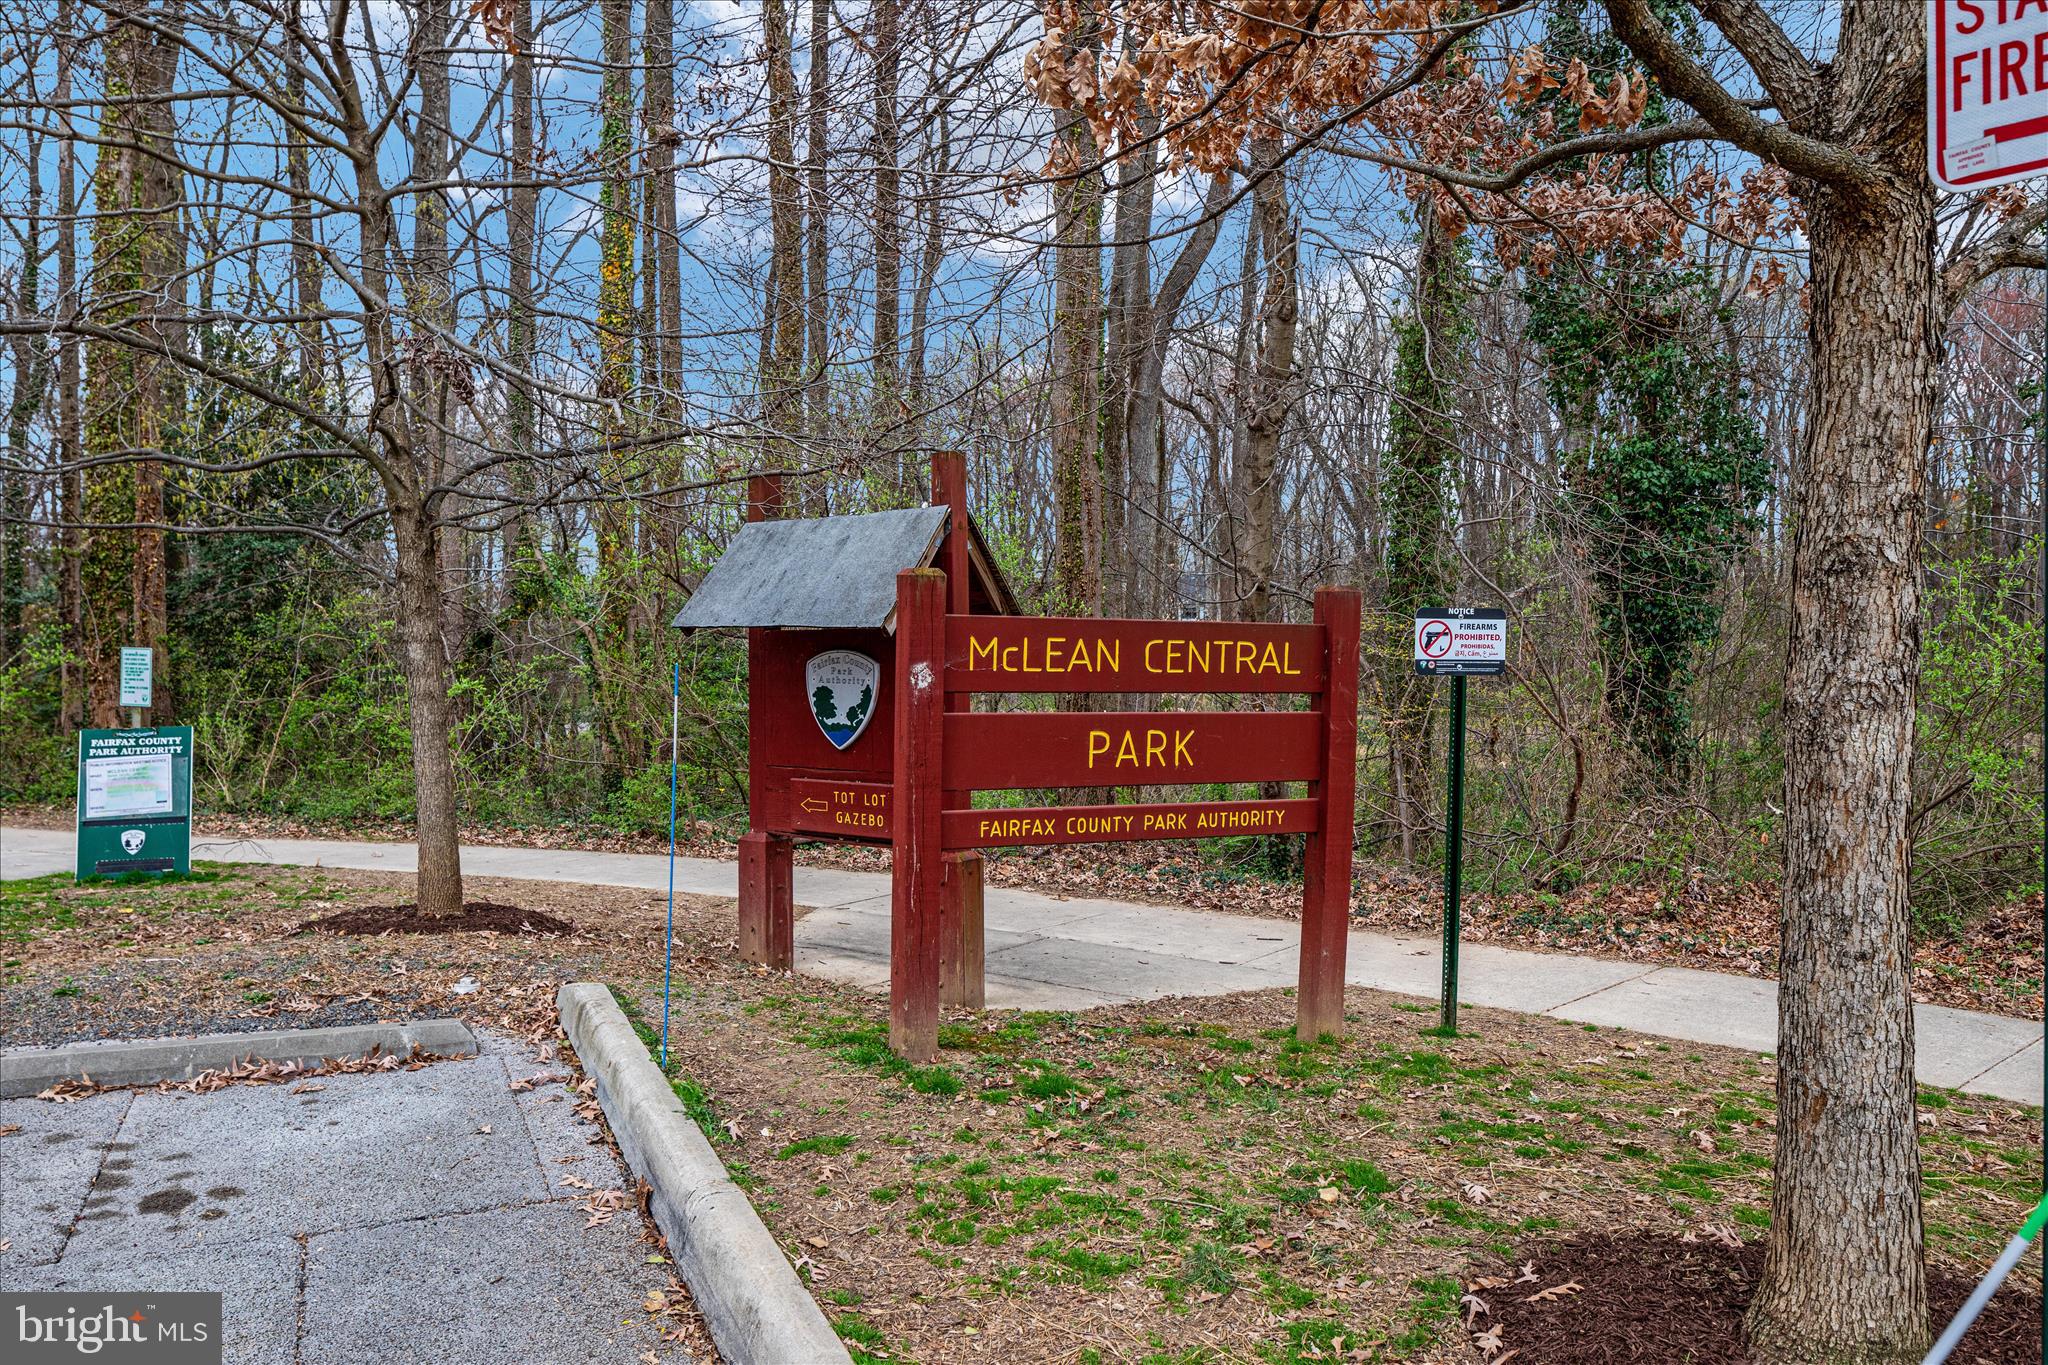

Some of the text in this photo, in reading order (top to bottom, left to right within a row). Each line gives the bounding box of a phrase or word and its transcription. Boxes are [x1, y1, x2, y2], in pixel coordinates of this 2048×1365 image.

[1953, 32, 2048, 112] FIRE
[1459, 623, 1498, 631] FIREARMS
[1454, 633, 1502, 642] PROHIBITED,
[968, 635, 1301, 675] McLEAN CENTRAL
[812, 655, 873, 675] Fairfax County
[830, 667, 853, 675] Park
[818, 675, 866, 686] Authority
[91, 736, 182, 747] FAIRFAX COUNTY
[1088, 729, 1196, 769] PARK
[89, 746, 183, 757] PARK AUTHORITY
[833, 791, 886, 807] TOT LOT
[836, 811, 884, 827] GAZEBO
[980, 809, 1286, 838] FAIRFAX COUNTY PARK AUTHORITY
